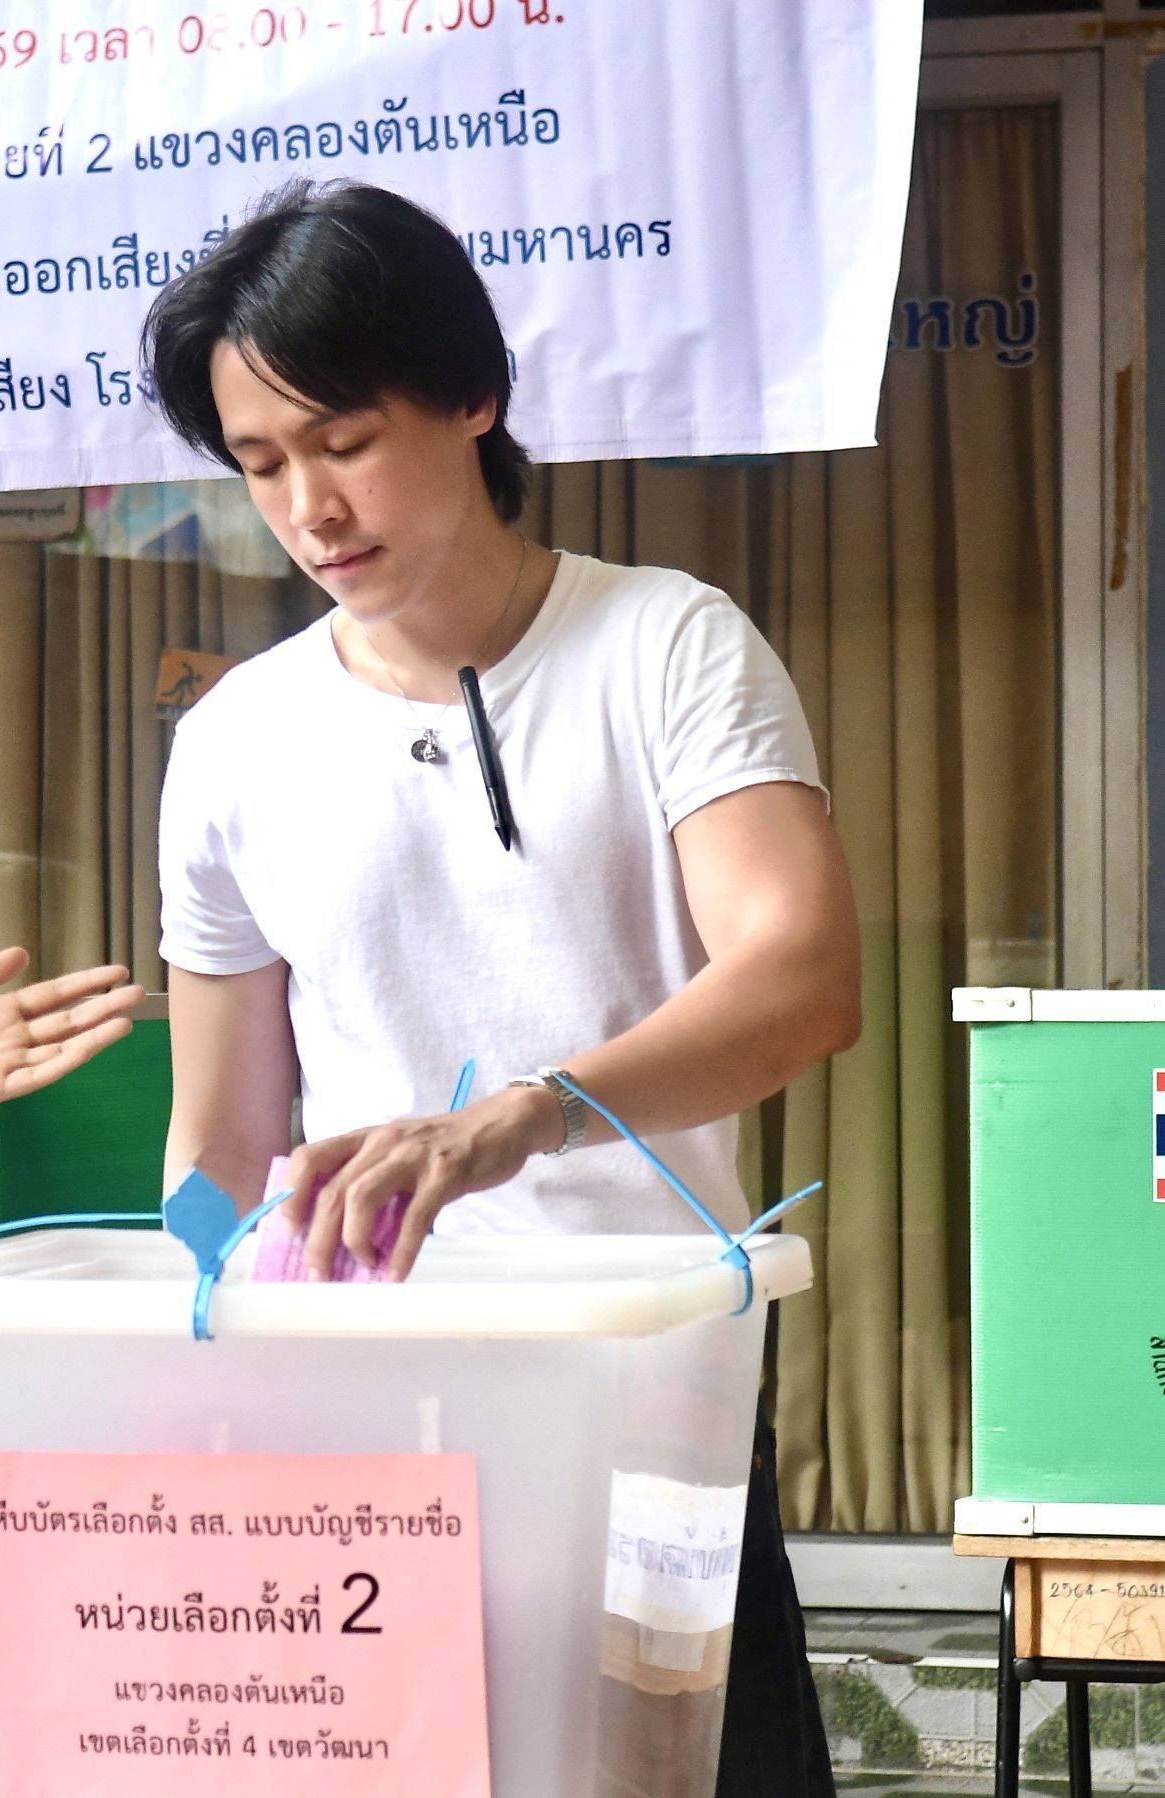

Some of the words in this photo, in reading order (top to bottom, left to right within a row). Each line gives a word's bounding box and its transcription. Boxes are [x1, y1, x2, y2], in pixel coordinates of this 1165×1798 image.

[86, 133, 113, 174] 2
[134, 88, 561, 171] แขวงคลองตันเหนือ
[889, 272, 1036, 366] หญ่
[190, 1513, 233, 1537] สส.
[245, 1497, 462, 1546] แบบบัญชีรายชื่อ
[75, 1580, 322, 1634] หน่วยเลือกตั้งที่
[341, 1572, 383, 1635] 2
[115, 1674, 346, 1706] แขวงคลองตันเหนือ
[79, 1718, 232, 1758] เขตเลือกตั้งที่
[242, 1735, 257, 1757] 4
[269, 1729, 390, 1760] เขตวัฒนา
